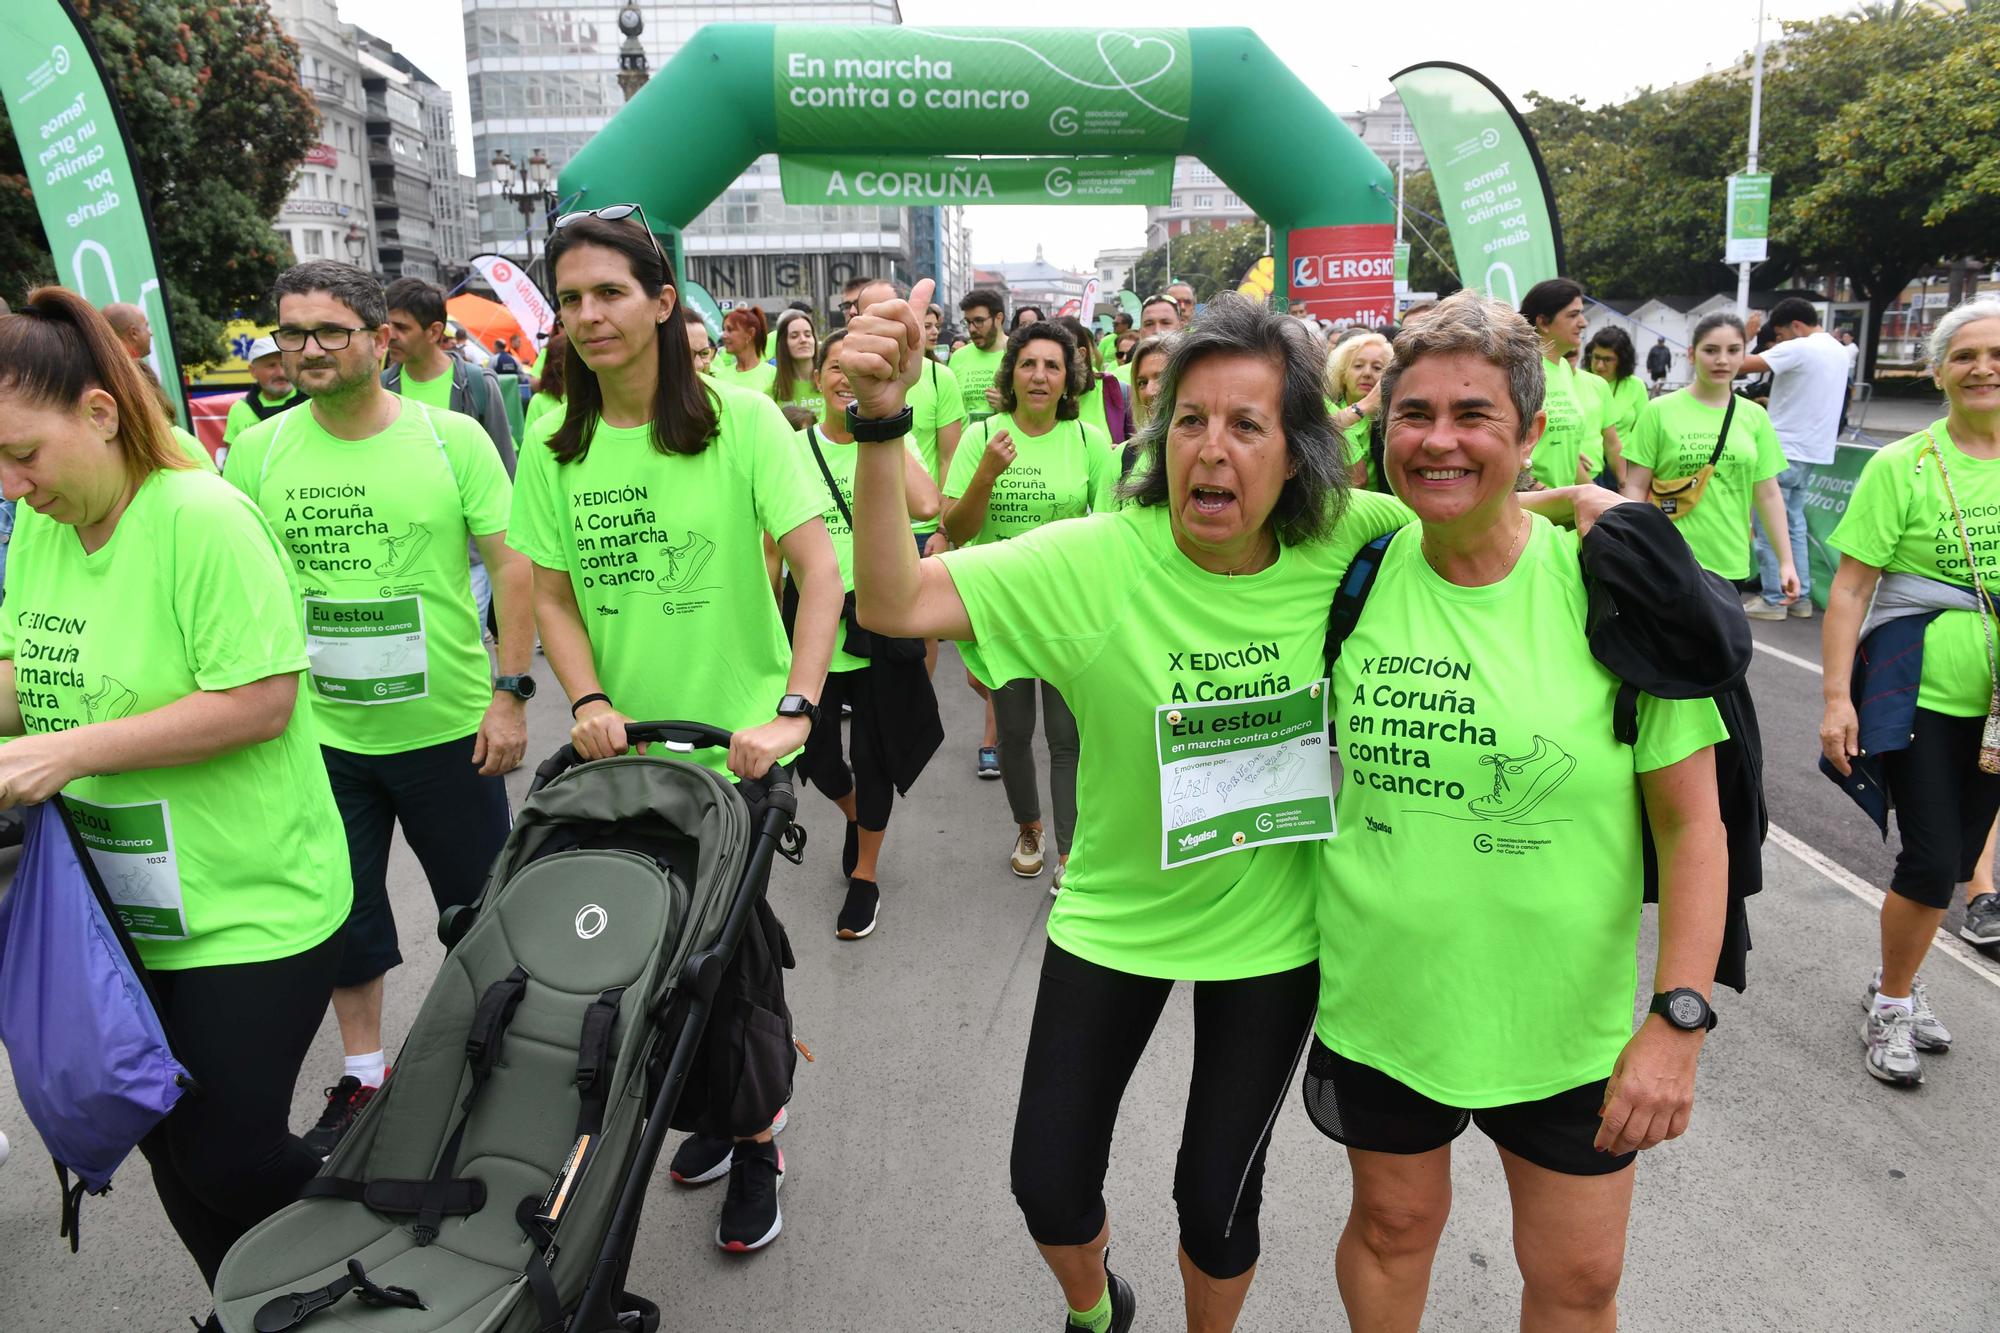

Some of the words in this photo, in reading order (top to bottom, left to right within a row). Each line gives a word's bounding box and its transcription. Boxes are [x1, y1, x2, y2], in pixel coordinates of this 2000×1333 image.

[788, 53, 825, 78] En
[834, 54, 953, 81] marcha
[790, 84, 889, 108] contra
[898, 88, 917, 108] o
[925, 88, 1030, 110] cancro
[826, 171, 849, 196] A
[855, 166, 995, 197] CORUÑA
[1690, 442, 1728, 451] Corua
[285, 488, 296, 500] X
[300, 483, 366, 500] EDICIÓN
[1000, 479, 1046, 489] Coruña
[574, 494, 582, 508] X
[583, 484, 648, 506] EDICIÓN
[1006, 490, 1056, 500] marcha
[284, 507, 297, 522] A
[302, 503, 374, 521] Coruña
[990, 502, 1028, 512] contra
[574, 516, 584, 532] A
[588, 508, 656, 530] Coruña
[992, 514, 998, 522] o
[1000, 514, 1041, 523] cancro
[1938, 512, 1947, 522] X
[285, 526, 309, 540] en
[314, 521, 389, 539] marcha
[577, 537, 596, 552] en
[600, 527, 669, 550] marcha
[1936, 528, 1948, 540] A
[291, 539, 350, 555] contra
[1936, 543, 1958, 554] en
[297, 559, 306, 571] o
[309, 557, 372, 572] cancro
[580, 551, 638, 570] contra
[1936, 555, 1996, 568] contra
[584, 576, 594, 588] o
[598, 568, 655, 587] cancro
[312, 606, 330, 622] Eu
[333, 608, 384, 622] estou
[321, 624, 350, 633] marcha
[385, 622, 412, 631] cancro
[1168, 652, 1184, 672] X
[1190, 642, 1280, 671] EDICIÓN
[1361, 658, 1376, 675] X
[1376, 656, 1472, 681] EDICIÓN
[1172, 682, 1188, 704] A
[1196, 672, 1291, 703] Coruña
[1352, 684, 1366, 706] A
[1372, 684, 1476, 715] Coruña
[1172, 716, 1204, 737] Eu
[1212, 710, 1282, 732] estou
[1350, 714, 1374, 734] en
[1381, 718, 1497, 747] marcha
[1172, 743, 1185, 754] en
[1188, 738, 1231, 750] marcha
[1233, 732, 1269, 745] contra
[1280, 720, 1312, 736] cancro
[1300, 737, 1322, 747] 0090
[1350, 741, 1430, 769] contra
[1352, 769, 1365, 786] o
[1370, 770, 1465, 800] cancro
[70, 809, 112, 832] stou
[106, 838, 113, 846] o
[115, 838, 153, 848] cancro
[1178, 829, 1218, 848] Vegalsa
[146, 856, 168, 865] 1032
